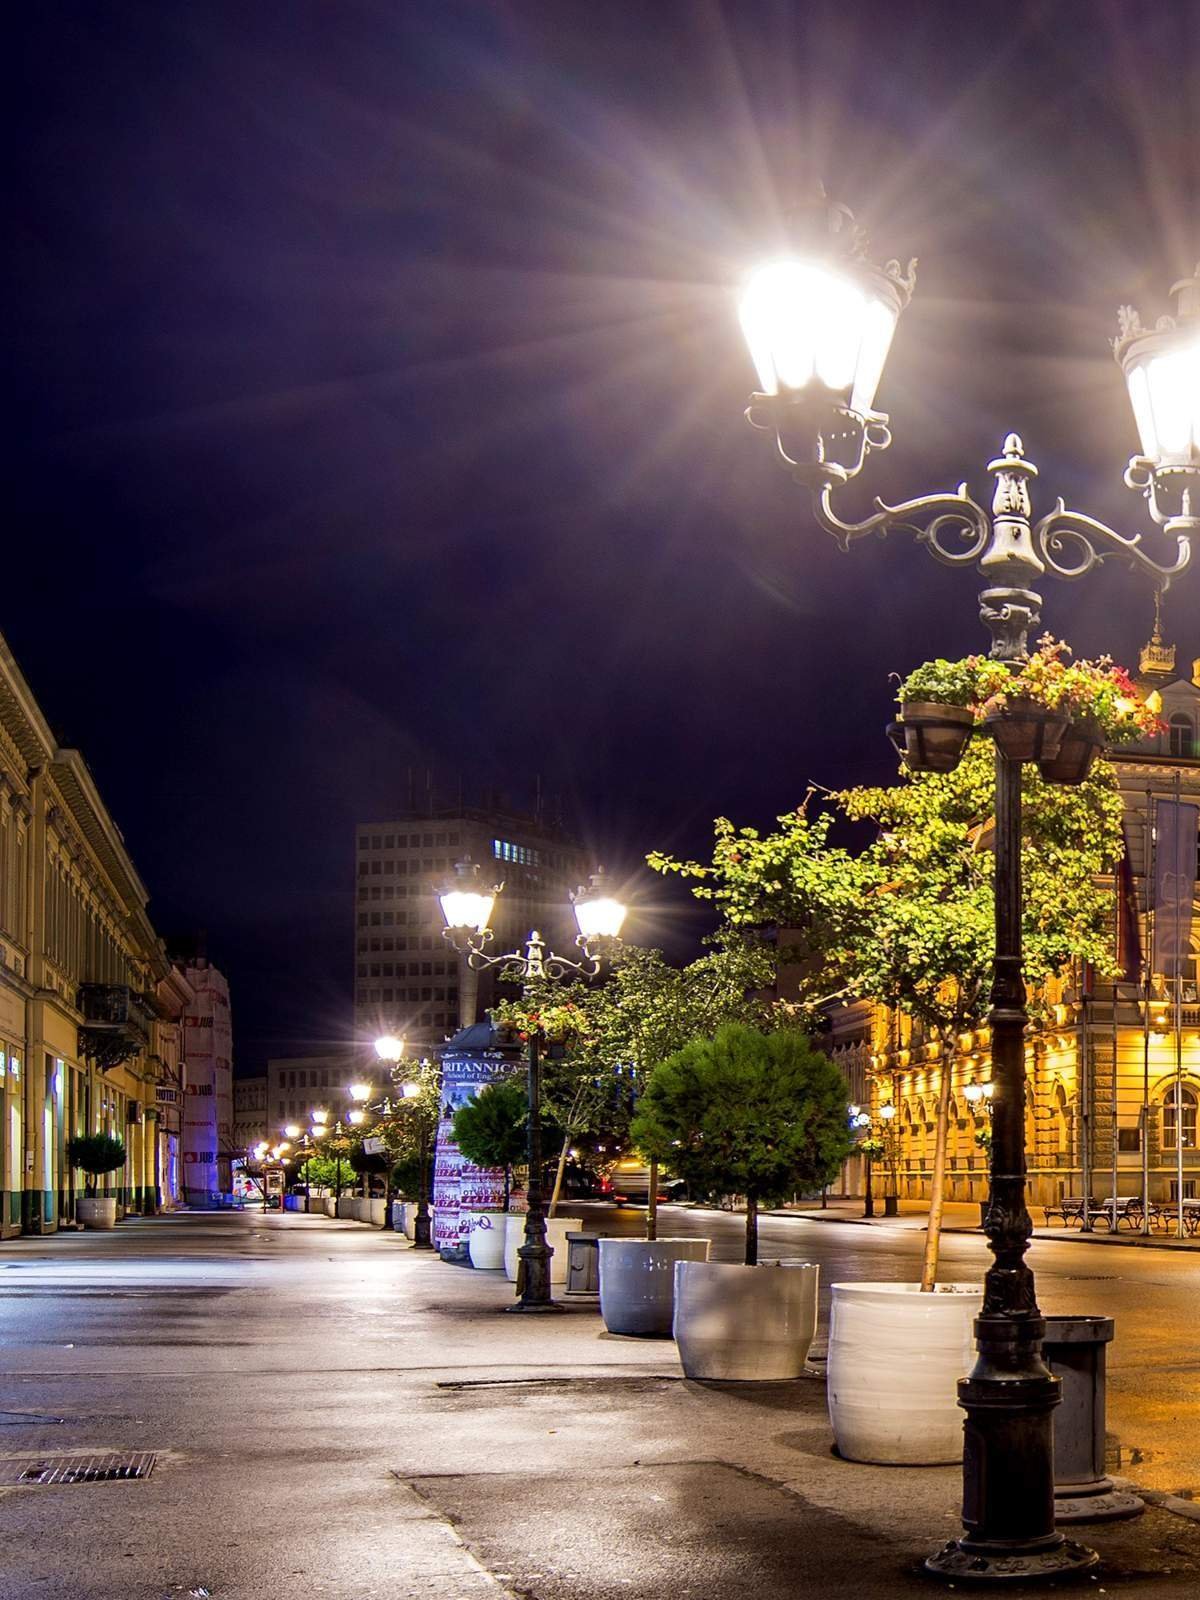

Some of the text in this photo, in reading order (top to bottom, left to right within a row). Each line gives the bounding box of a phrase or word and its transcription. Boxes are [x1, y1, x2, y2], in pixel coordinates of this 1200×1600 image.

[198, 1016, 214, 1028] JUB
[198, 1084, 213, 1096] JUB
[198, 1151, 214, 1164] JUB
